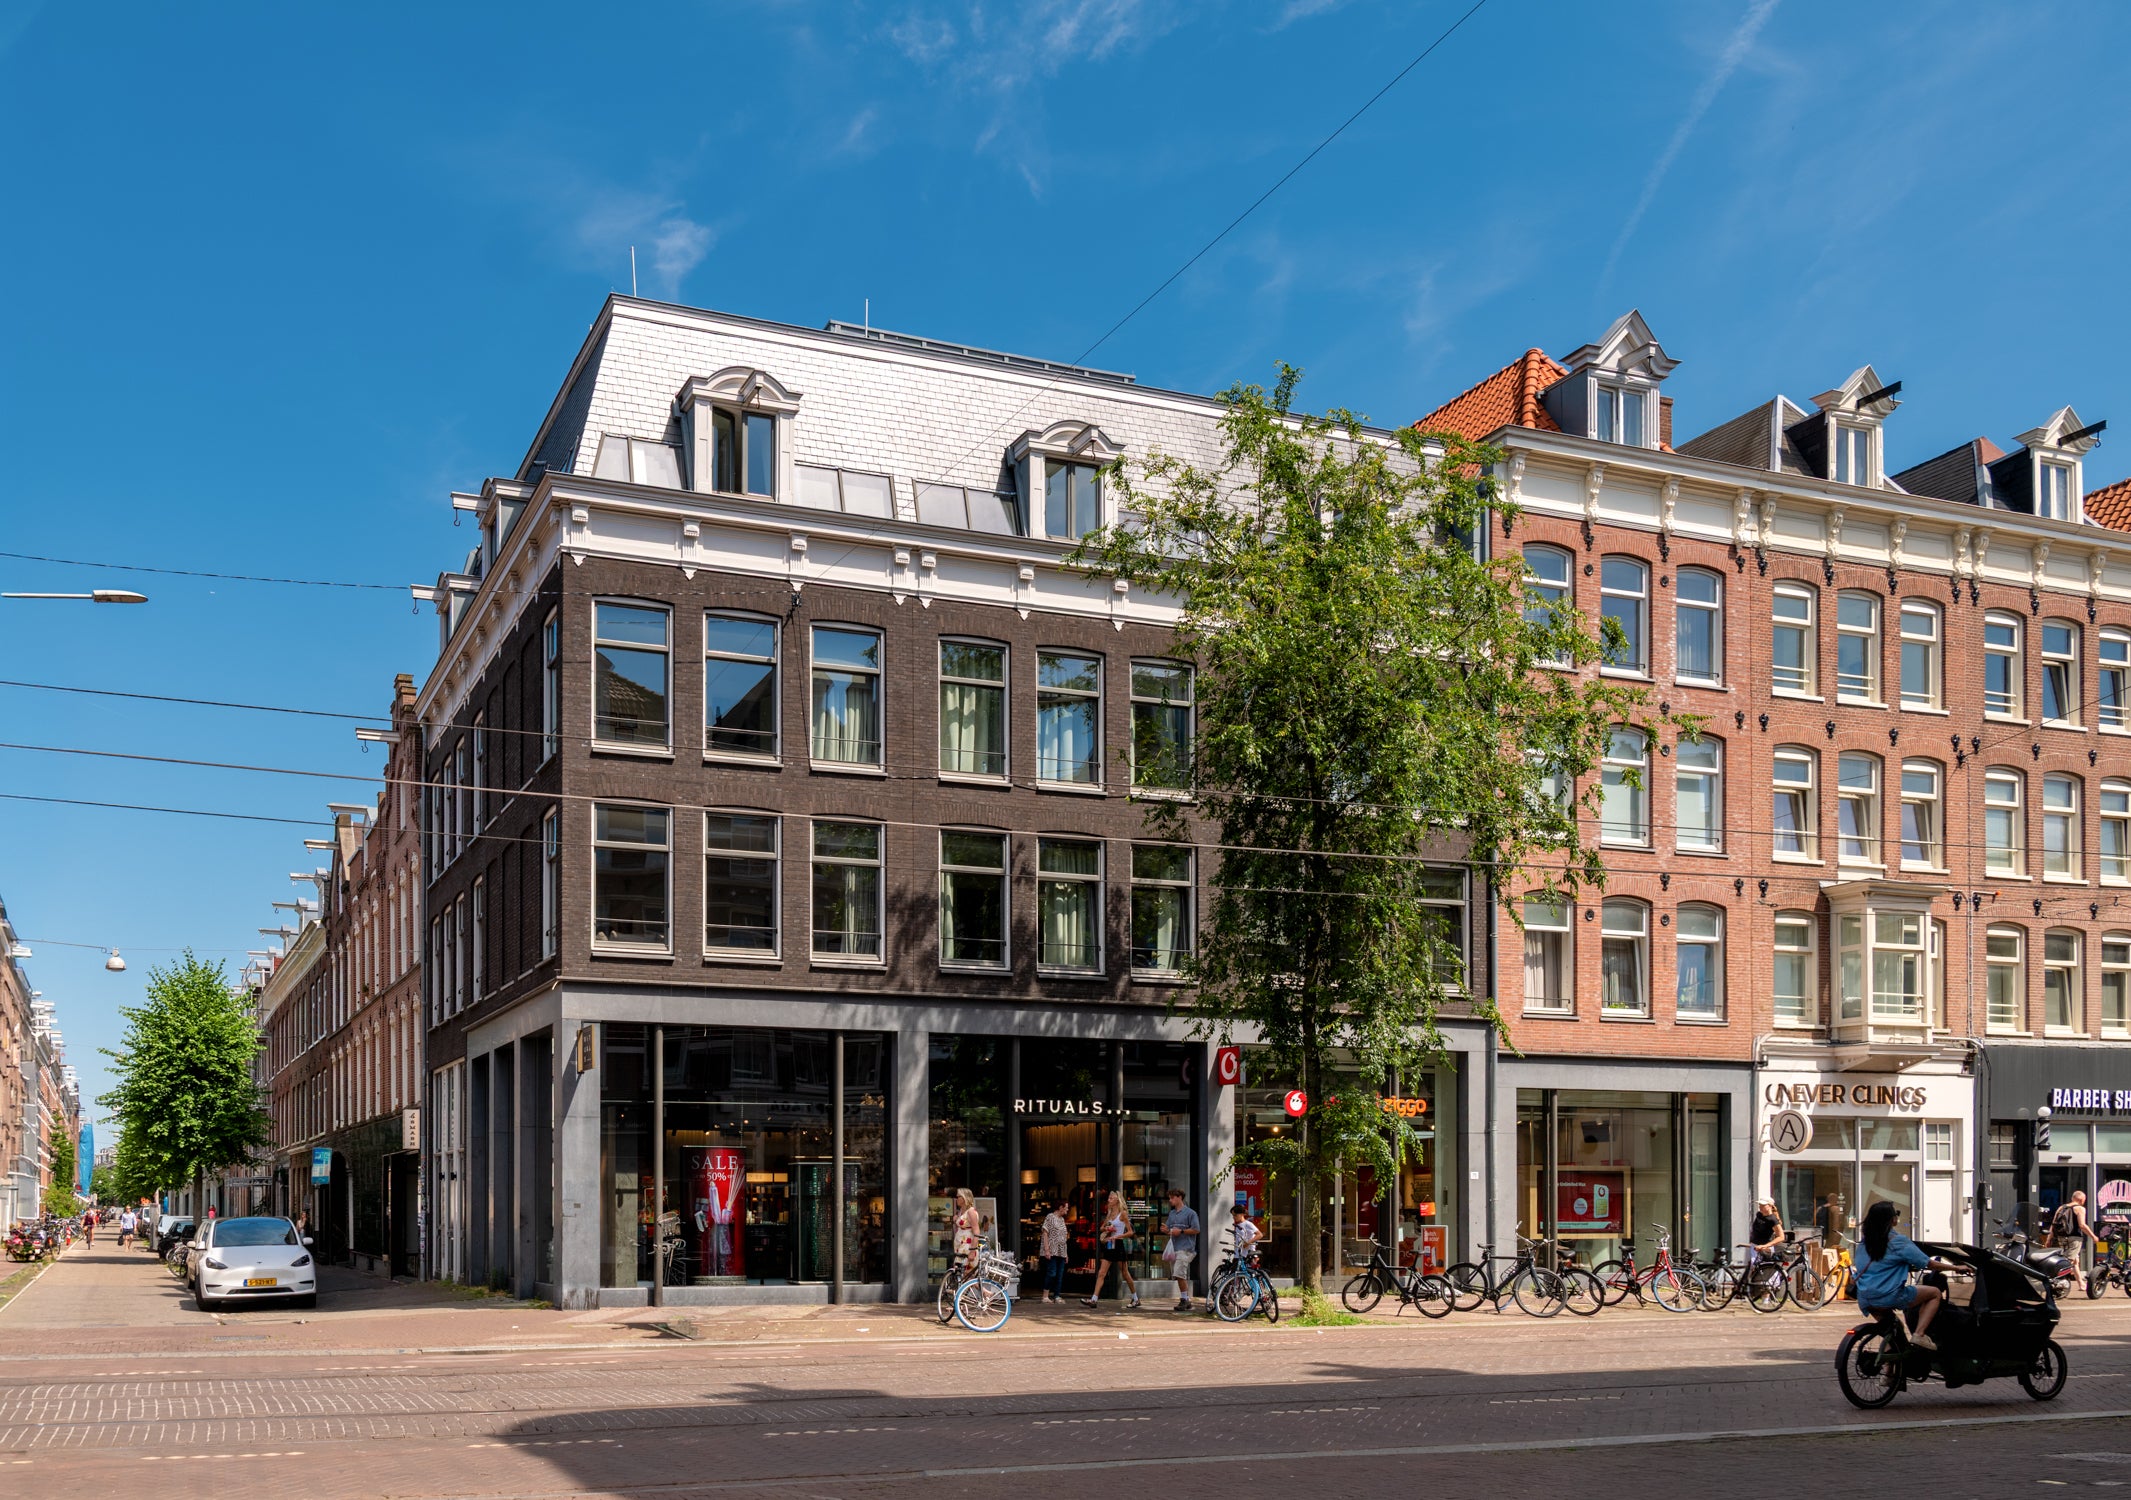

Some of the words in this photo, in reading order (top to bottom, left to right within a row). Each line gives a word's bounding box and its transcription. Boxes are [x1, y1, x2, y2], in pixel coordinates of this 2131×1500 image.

[1852, 1085, 1927, 1106] CLINICS
[2052, 1088, 2110, 1108] BARBER
[1383, 1095, 1427, 1117] ziggo
[691, 1155, 738, 1170] SALE
[706, 1172, 727, 1181] 50%
